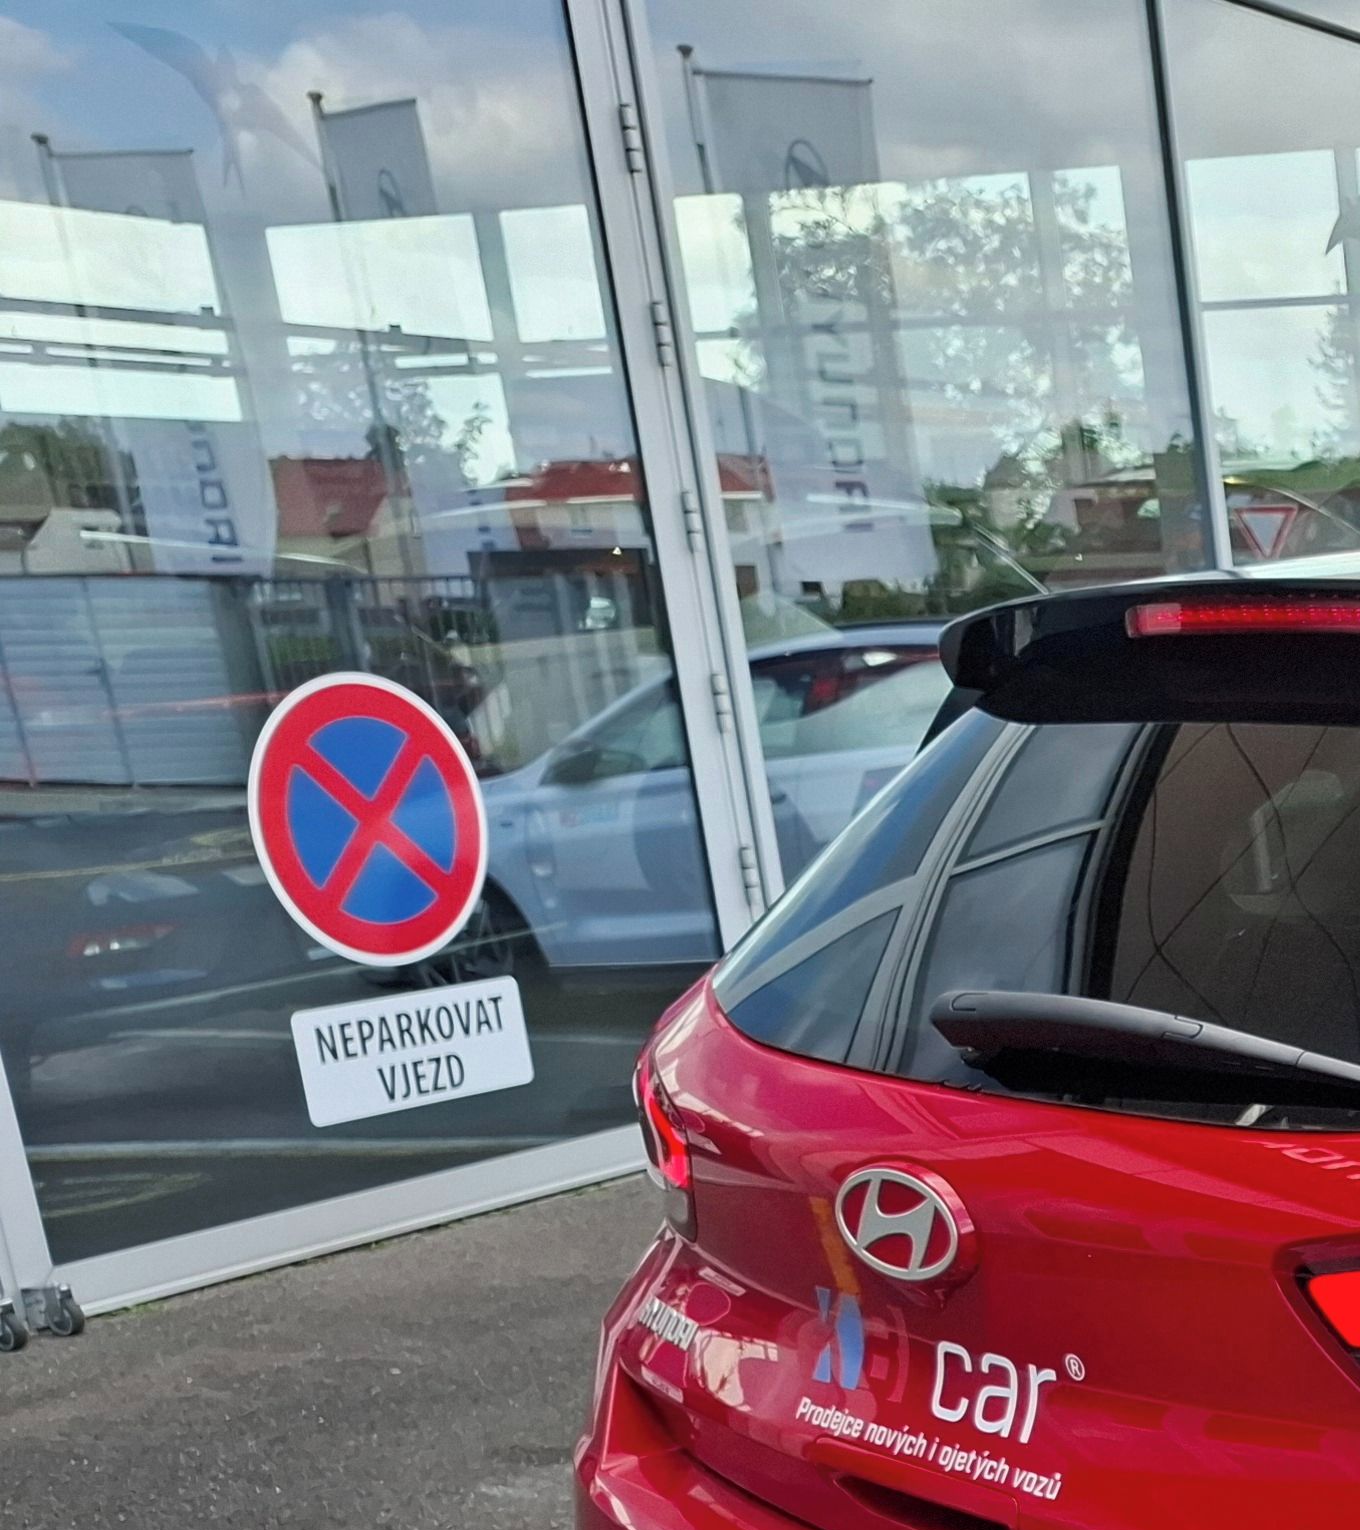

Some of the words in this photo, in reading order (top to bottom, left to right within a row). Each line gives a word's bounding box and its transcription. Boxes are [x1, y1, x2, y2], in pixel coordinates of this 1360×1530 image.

[314, 996, 503, 1064] NEPARKOVAT
[377, 1054, 465, 1102] VJEZD
[796, 1396, 863, 1439] Prodejce
[863, 1424, 927, 1458] nových
[927, 1436, 940, 1462] i
[938, 1443, 1010, 1484] ojetých
[1011, 1472, 1063, 1501] vozů
